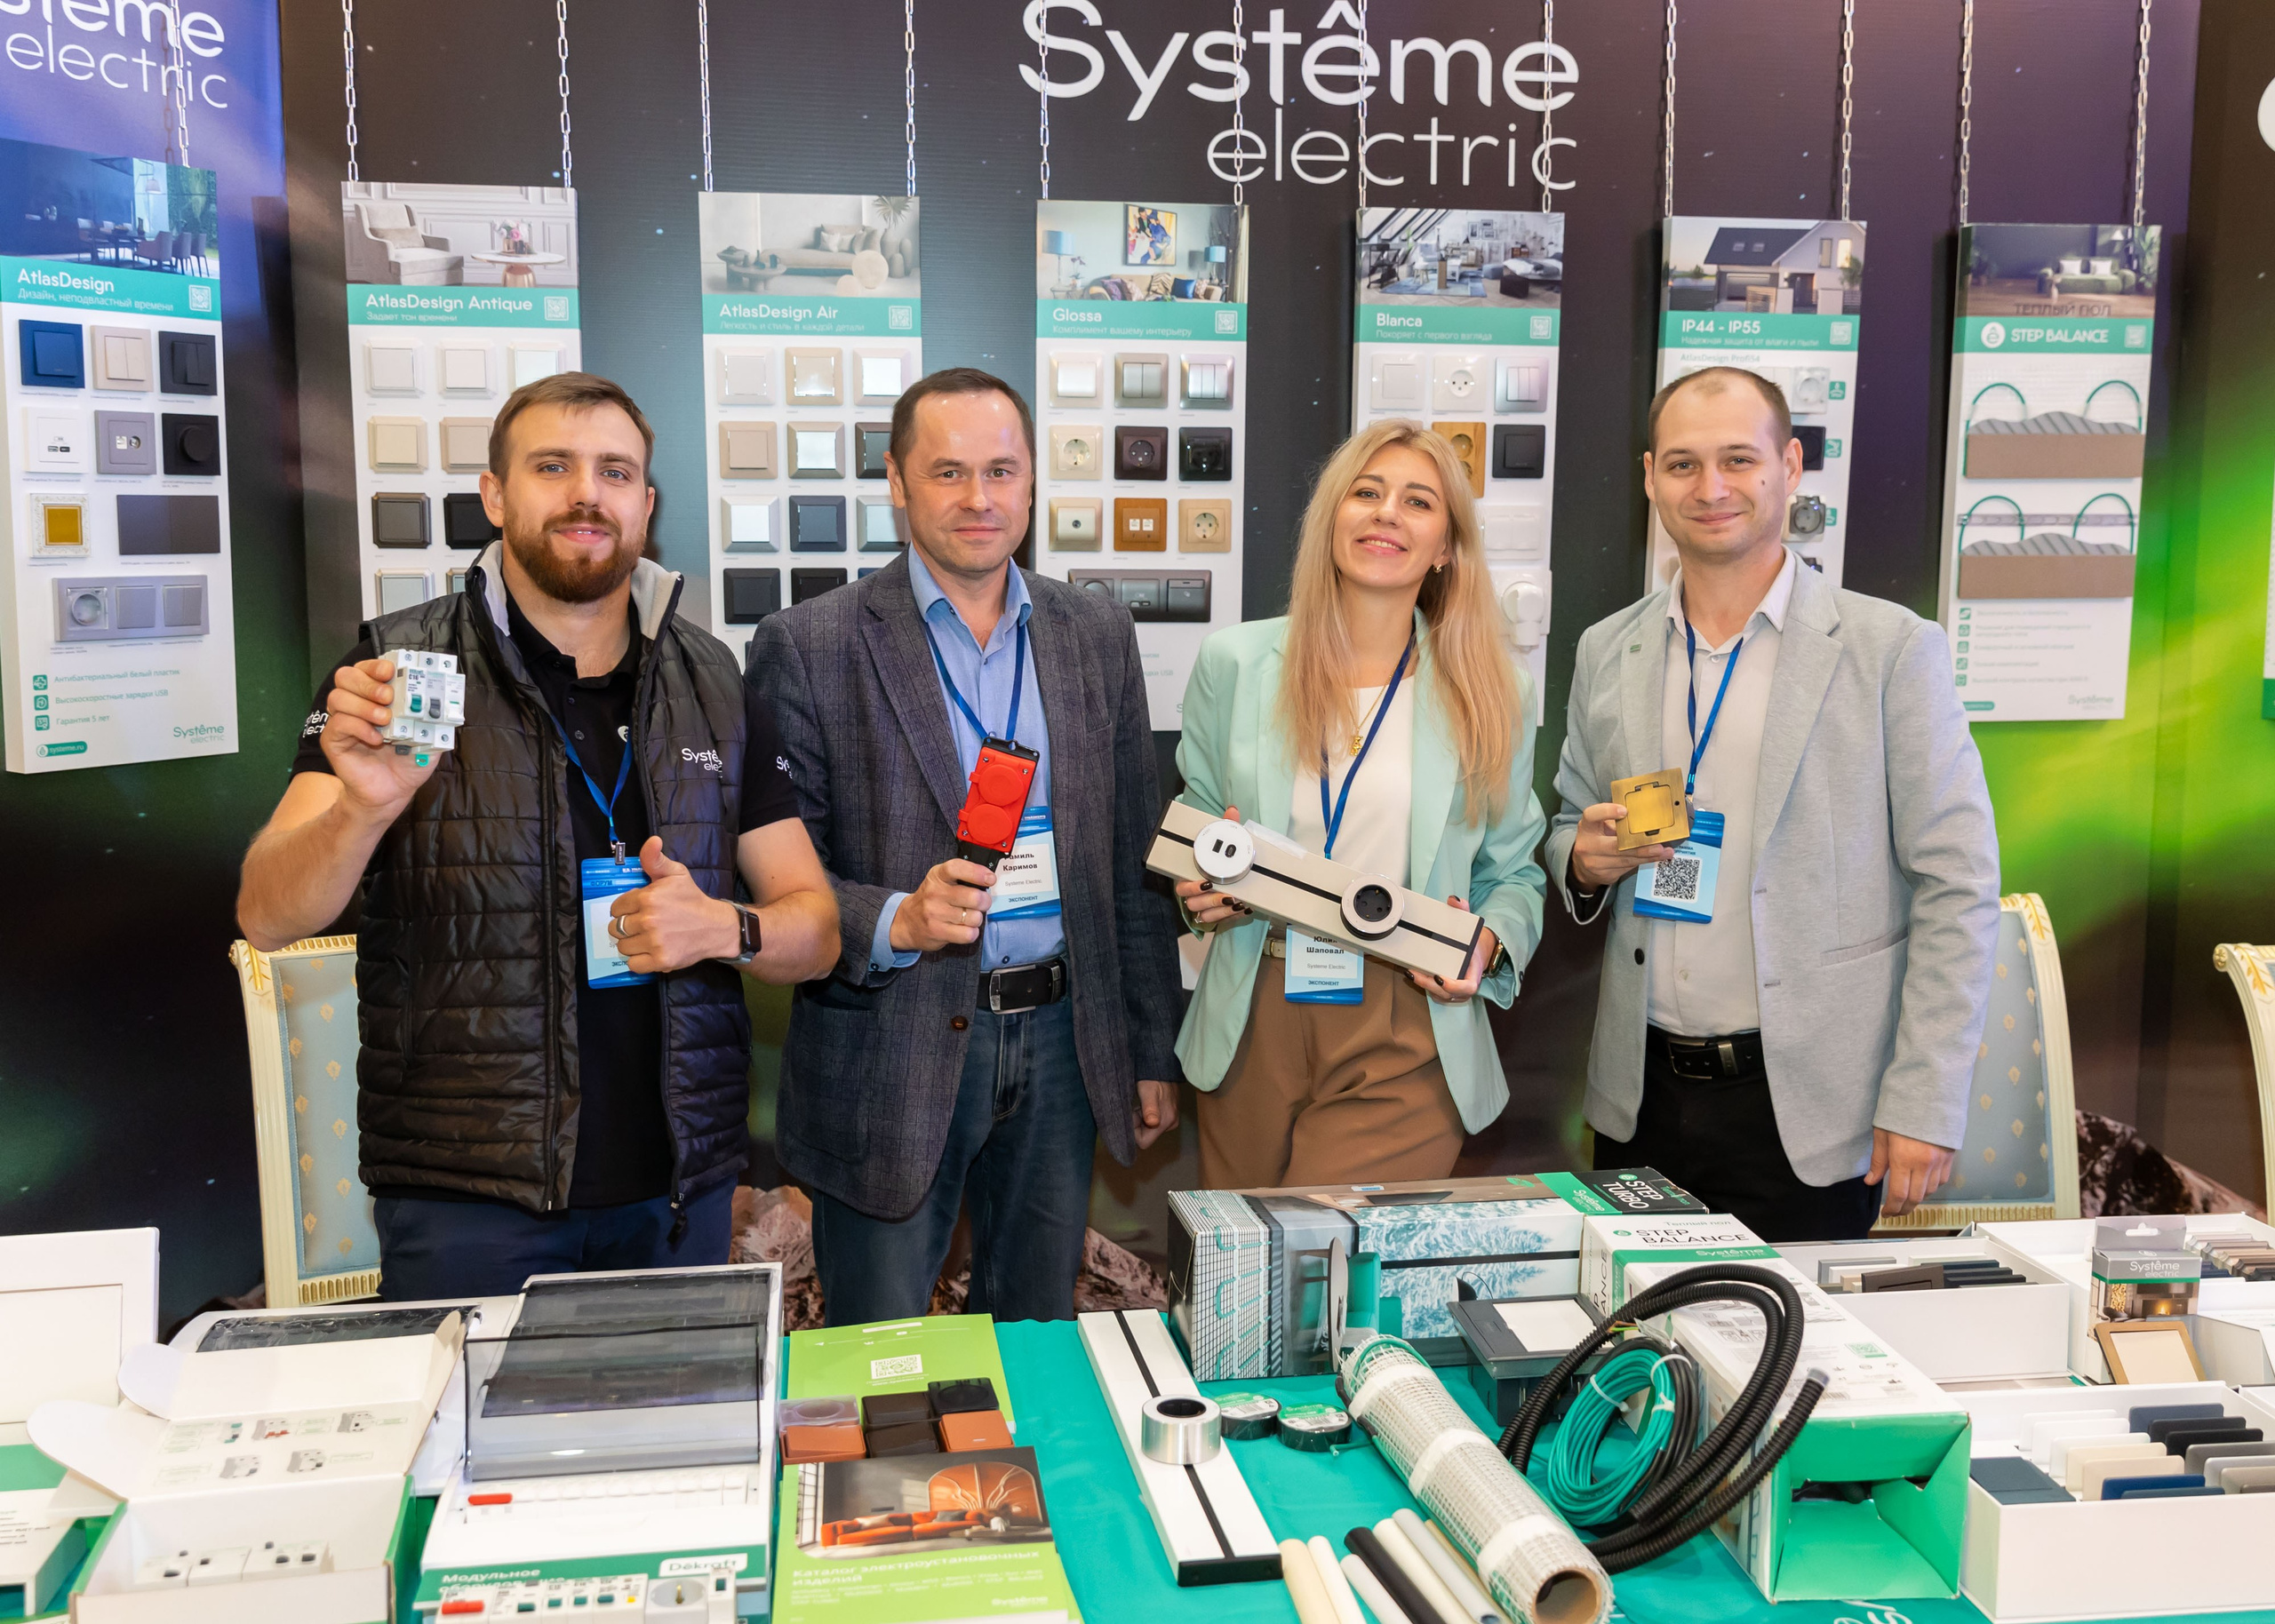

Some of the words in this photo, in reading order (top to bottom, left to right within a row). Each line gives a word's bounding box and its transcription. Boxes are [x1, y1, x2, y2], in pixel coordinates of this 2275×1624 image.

[1018, 0, 1579, 122] Système
[5, 33, 228, 108] electric
[1207, 107, 1577, 190] electric
[18, 268, 115, 294] AtlasDesign
[19, 288, 57, 301] Дизайн,
[59, 293, 132, 308] неподвластный
[134, 301, 174, 312] времени
[365, 293, 464, 312] AtlasDesign
[468, 295, 533, 313] Antique
[720, 303, 812, 322] AtlasDesign
[816, 305, 838, 319] Air
[1052, 307, 1102, 322] Glossa
[2079, 304, 2111, 316] ПОЛ
[1377, 313, 1423, 327] Blanca
[1681, 319, 1714, 333] IP44
[1728, 320, 1761, 334] IP55
[1052, 324, 1107, 335] Комплимент
[1110, 326, 1145, 337] вашему
[1145, 327, 1193, 338] интерьеру
[2011, 328, 2043, 343] STEP
[2046, 329, 2109, 344] BALANCE
[172, 724, 225, 738] Système
[1002, 863, 1038, 872] Каримов
[1008, 895, 1038, 904] ЭКСПОНЕНТ
[1602, 1182, 1649, 1209] TURBO
[1625, 1180, 1664, 1200] STEP
[1573, 1190, 1605, 1212] Système
[1642, 1234, 1750, 1244] BALANCE
[1696, 1248, 1764, 1257] Système
[2129, 1261, 2180, 1272] Système
[793, 1566, 858, 1578] Каталог
[859, 1551, 1040, 1573] электроустановочных
[442, 1568, 541, 1584] Модульное
[792, 1573, 863, 1587] изделий
